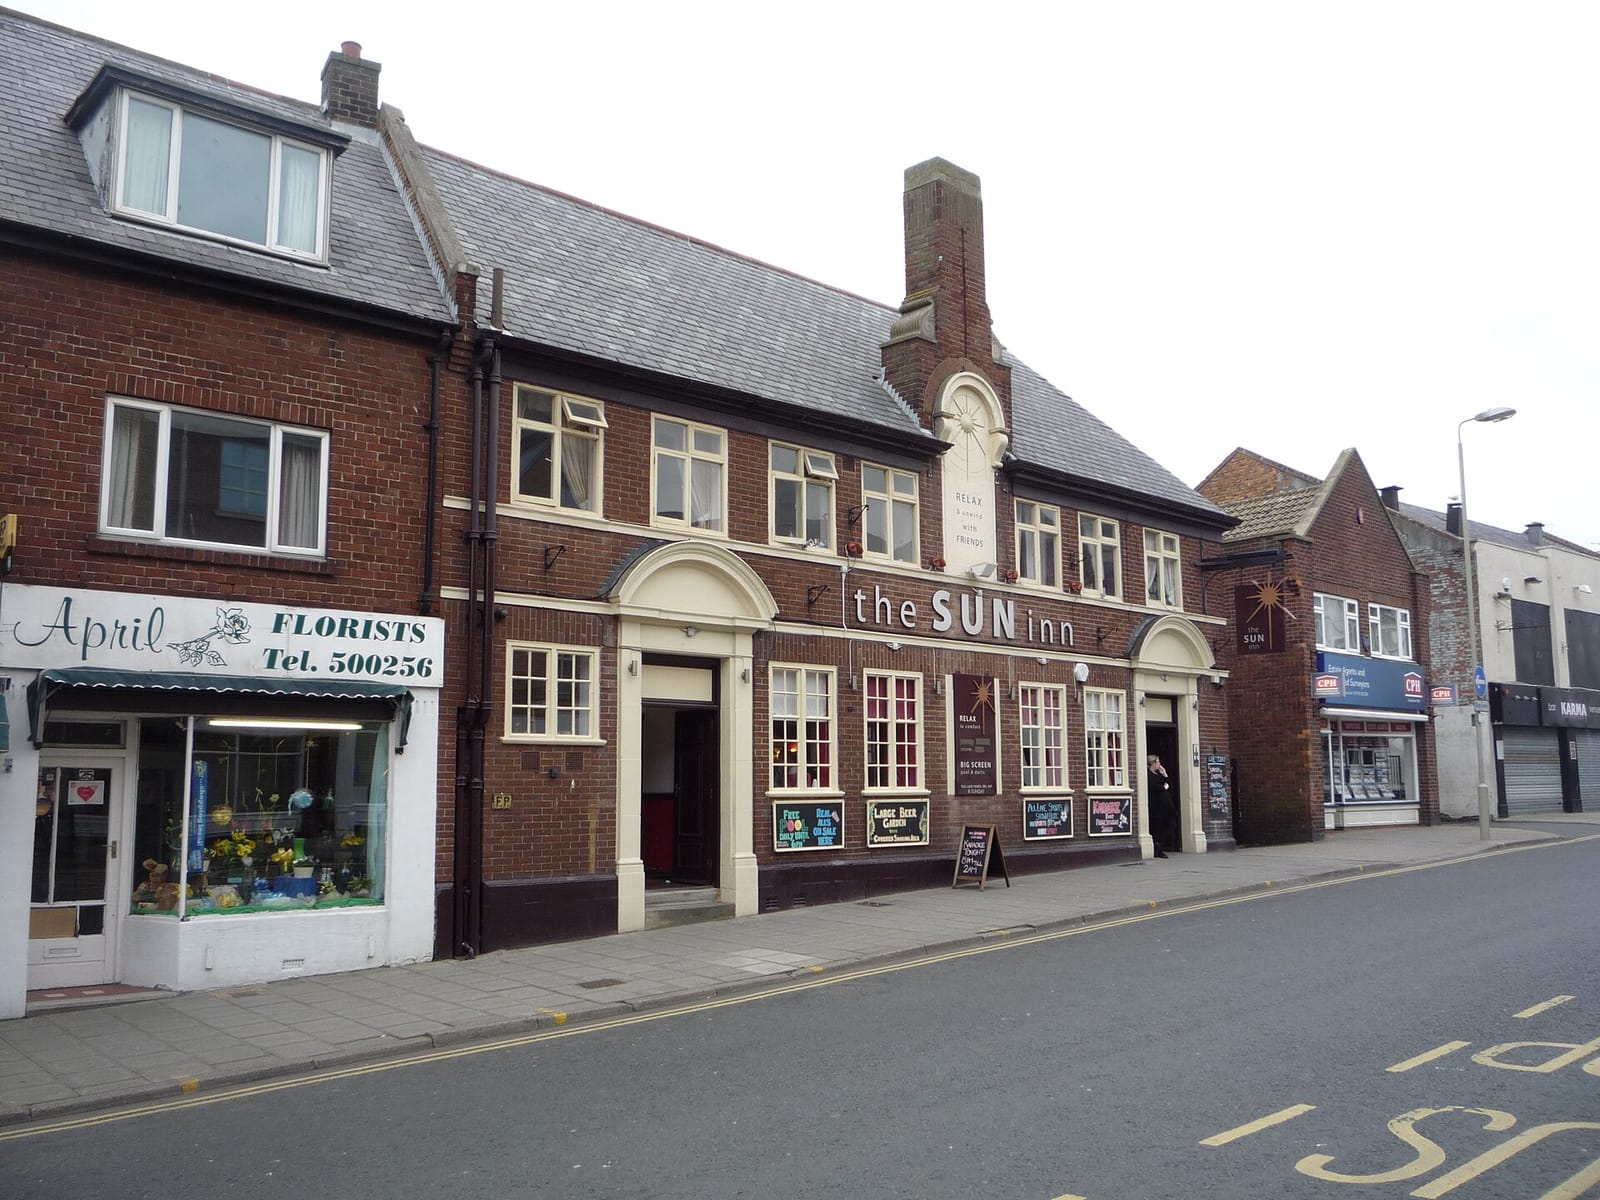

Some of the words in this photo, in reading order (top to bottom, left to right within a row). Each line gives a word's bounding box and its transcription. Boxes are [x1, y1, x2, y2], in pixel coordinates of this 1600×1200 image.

[956, 492, 981, 505] RELAX
[962, 524, 977, 532] with
[956, 535, 983, 547] FRIENDS
[854, 585, 916, 628] the
[932, 589, 1015, 640] SUN
[1027, 609, 1074, 646] inn
[13, 596, 165, 660] April
[271, 613, 427, 644] FLORISTS
[1243, 634, 1265, 643] SUN
[263, 648, 317, 672] Tel.
[329, 651, 433, 678] 500256
[1343, 666, 1357, 677] Agents
[1318, 679, 1337, 688] CPH
[1405, 678, 1421, 693] CPH
[1433, 690, 1451, 698] CPH
[1561, 702, 1587, 717] KARMA
[971, 761, 992, 769] SCREEN
[80, 770, 94, 780] 25
[783, 810, 800, 819] FREE
[875, 808, 896, 818] LARGE
[900, 806, 917, 818] BEER
[883, 818, 906, 828] GARDEN
[822, 827, 837, 836] SALE
